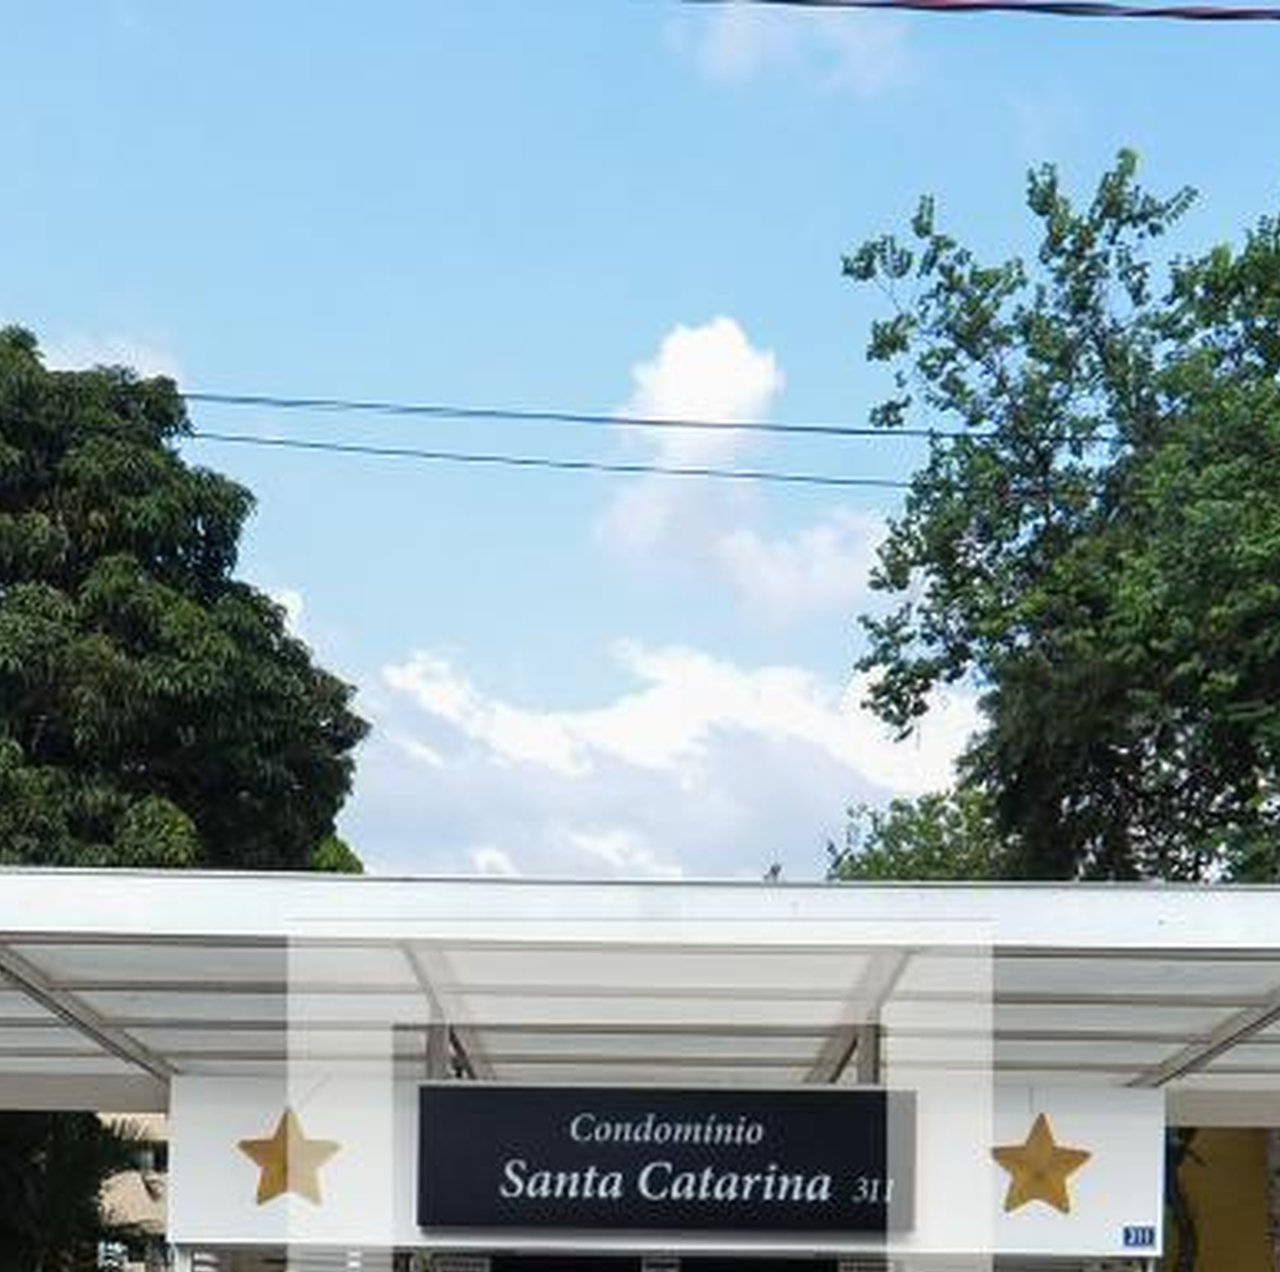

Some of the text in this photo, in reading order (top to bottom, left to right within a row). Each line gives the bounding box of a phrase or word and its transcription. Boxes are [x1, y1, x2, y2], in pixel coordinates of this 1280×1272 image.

[569, 1113, 764, 1145] Condomínio
[498, 1158, 895, 1202] Santa Catarina 311
